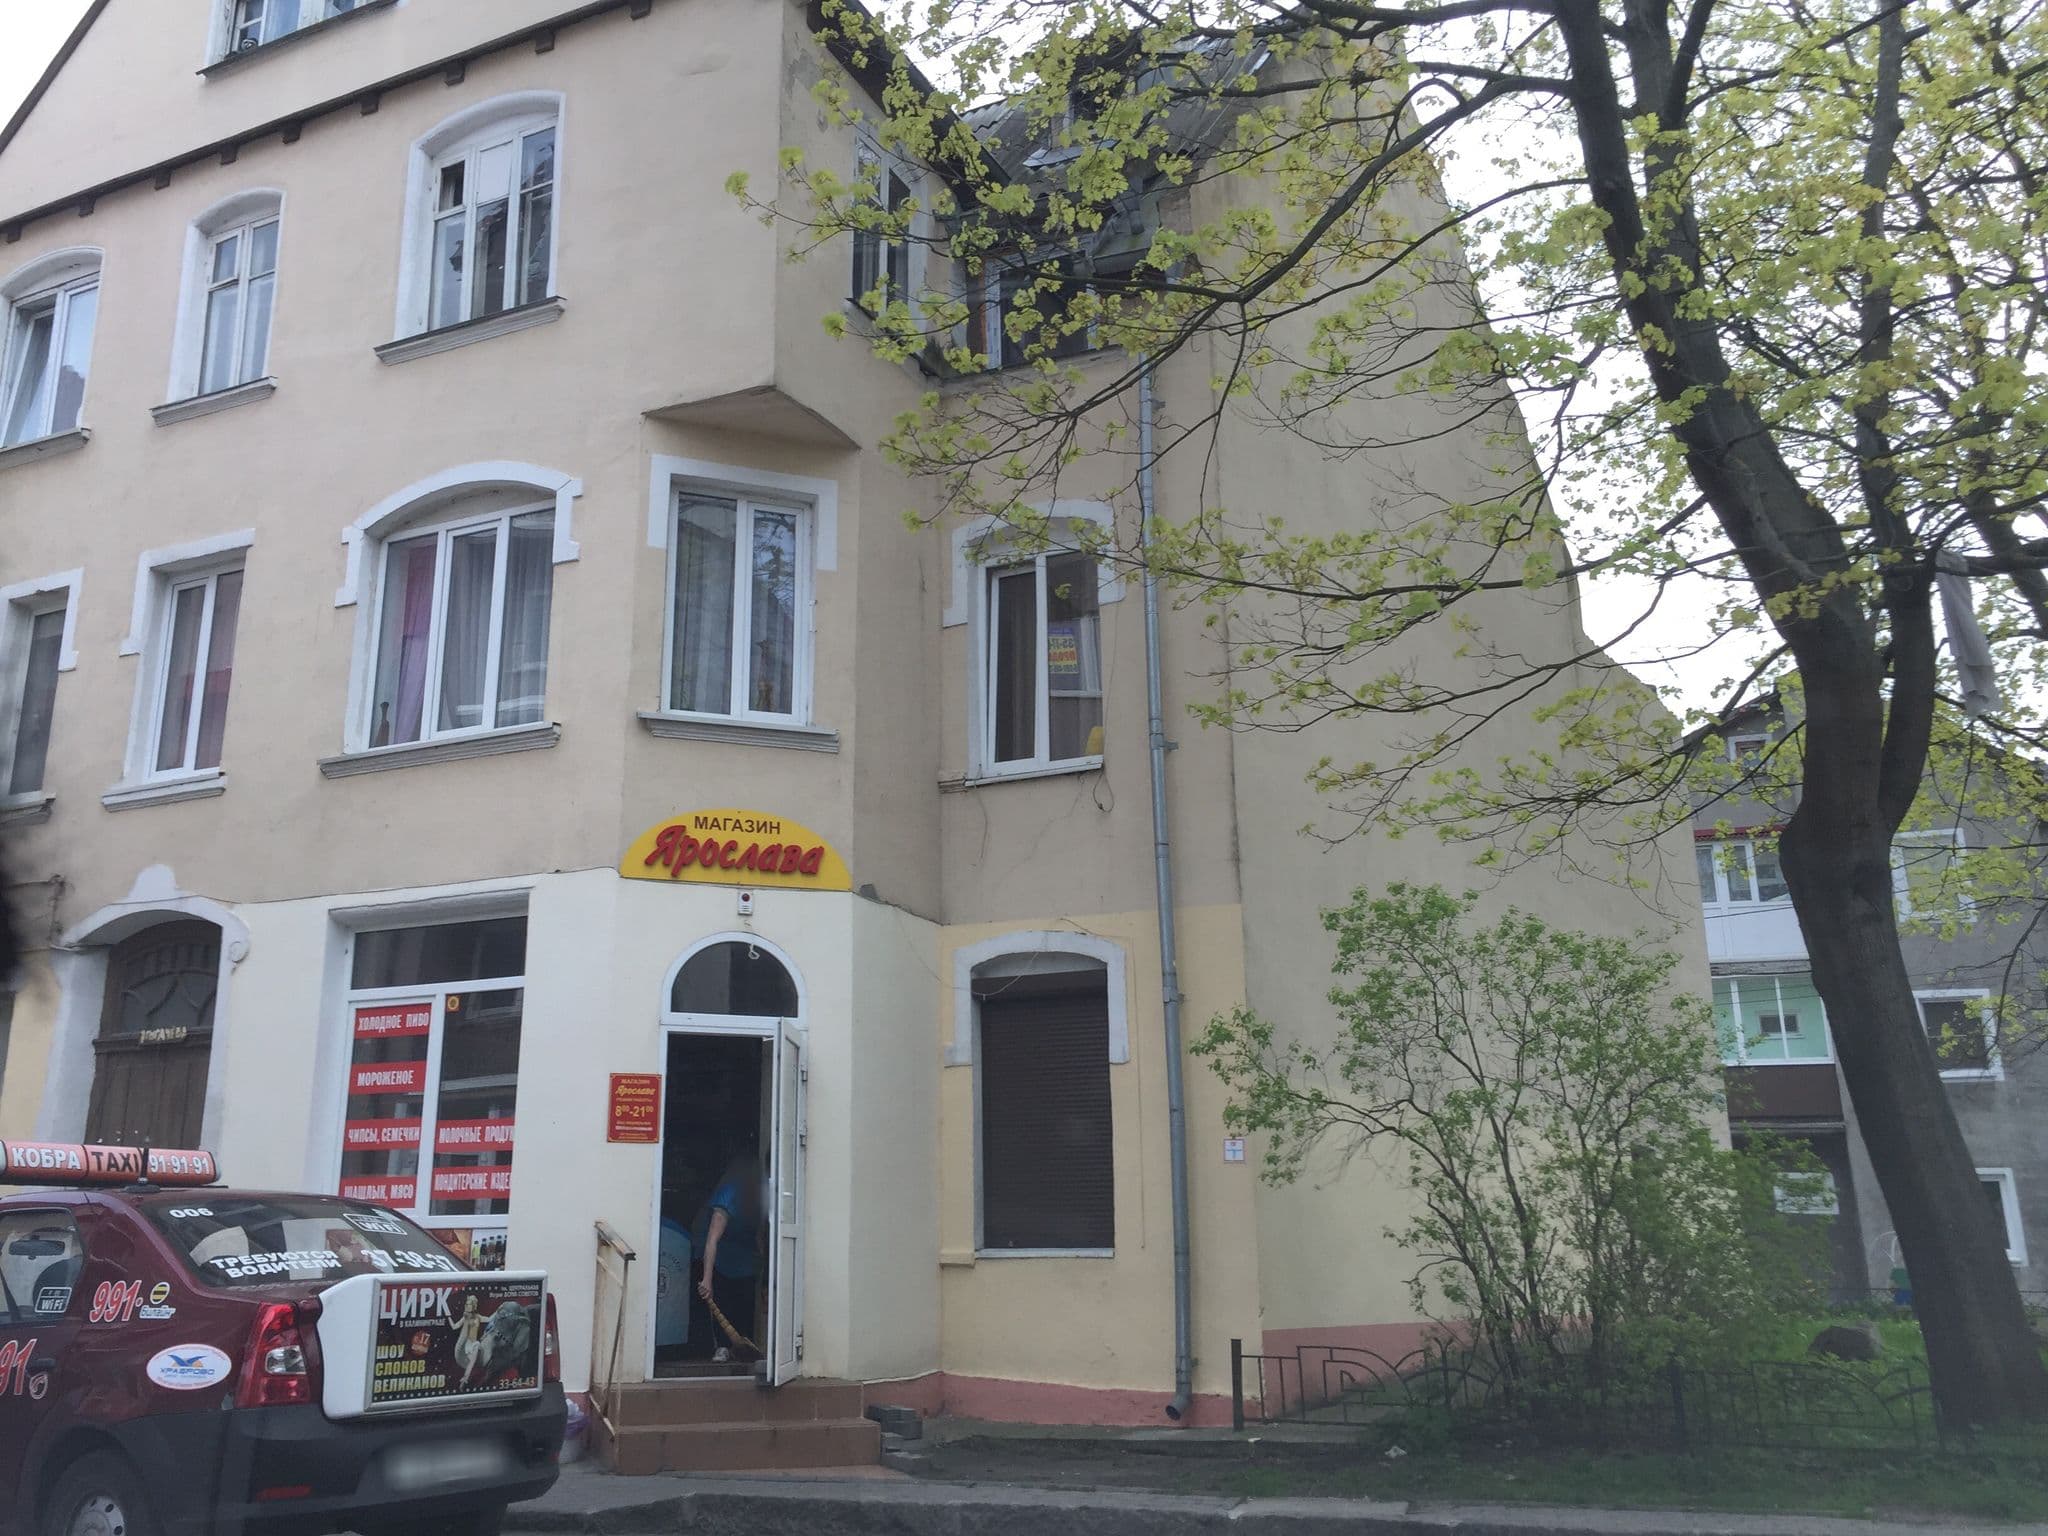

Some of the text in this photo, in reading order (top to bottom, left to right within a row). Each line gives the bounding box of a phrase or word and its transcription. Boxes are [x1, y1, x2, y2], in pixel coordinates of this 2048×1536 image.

[694, 815, 781, 835] МАГАЗИН
[644, 824, 825, 878] Ярослава
[357, 1012, 430, 1033] ХОЛОДНОЕ ПИВО
[357, 1070, 415, 1087] МОРОЖЕНОЕ
[348, 1126, 420, 1145] ЧИПСЫ, СЕМЕЧКИ
[439, 1126, 482, 1144] МОЛОЧНЫЕ
[11, 1147, 82, 1170] КОБРА
[91, 1151, 140, 1174] TAXI
[150, 1154, 210, 1175] 91-91-91
[390, 1184, 414, 1199] МЯСО
[434, 1172, 488, 1193] КОНДИТЕРСКИЕ
[169, 1207, 213, 1219] 006
[210, 1250, 339, 1268] ТРЕБУЮТСЯ
[225, 1258, 342, 1279] ВОДИТЕЛИ
[379, 1287, 453, 1325] ЦИРК
[376, 1345, 405, 1360] ШОУ
[160, 1367, 215, 1375] ХРАБРОВО
[375, 1359, 426, 1376] СЛОНОВ
[374, 1374, 446, 1393] ВЕЛИКАНОВ
